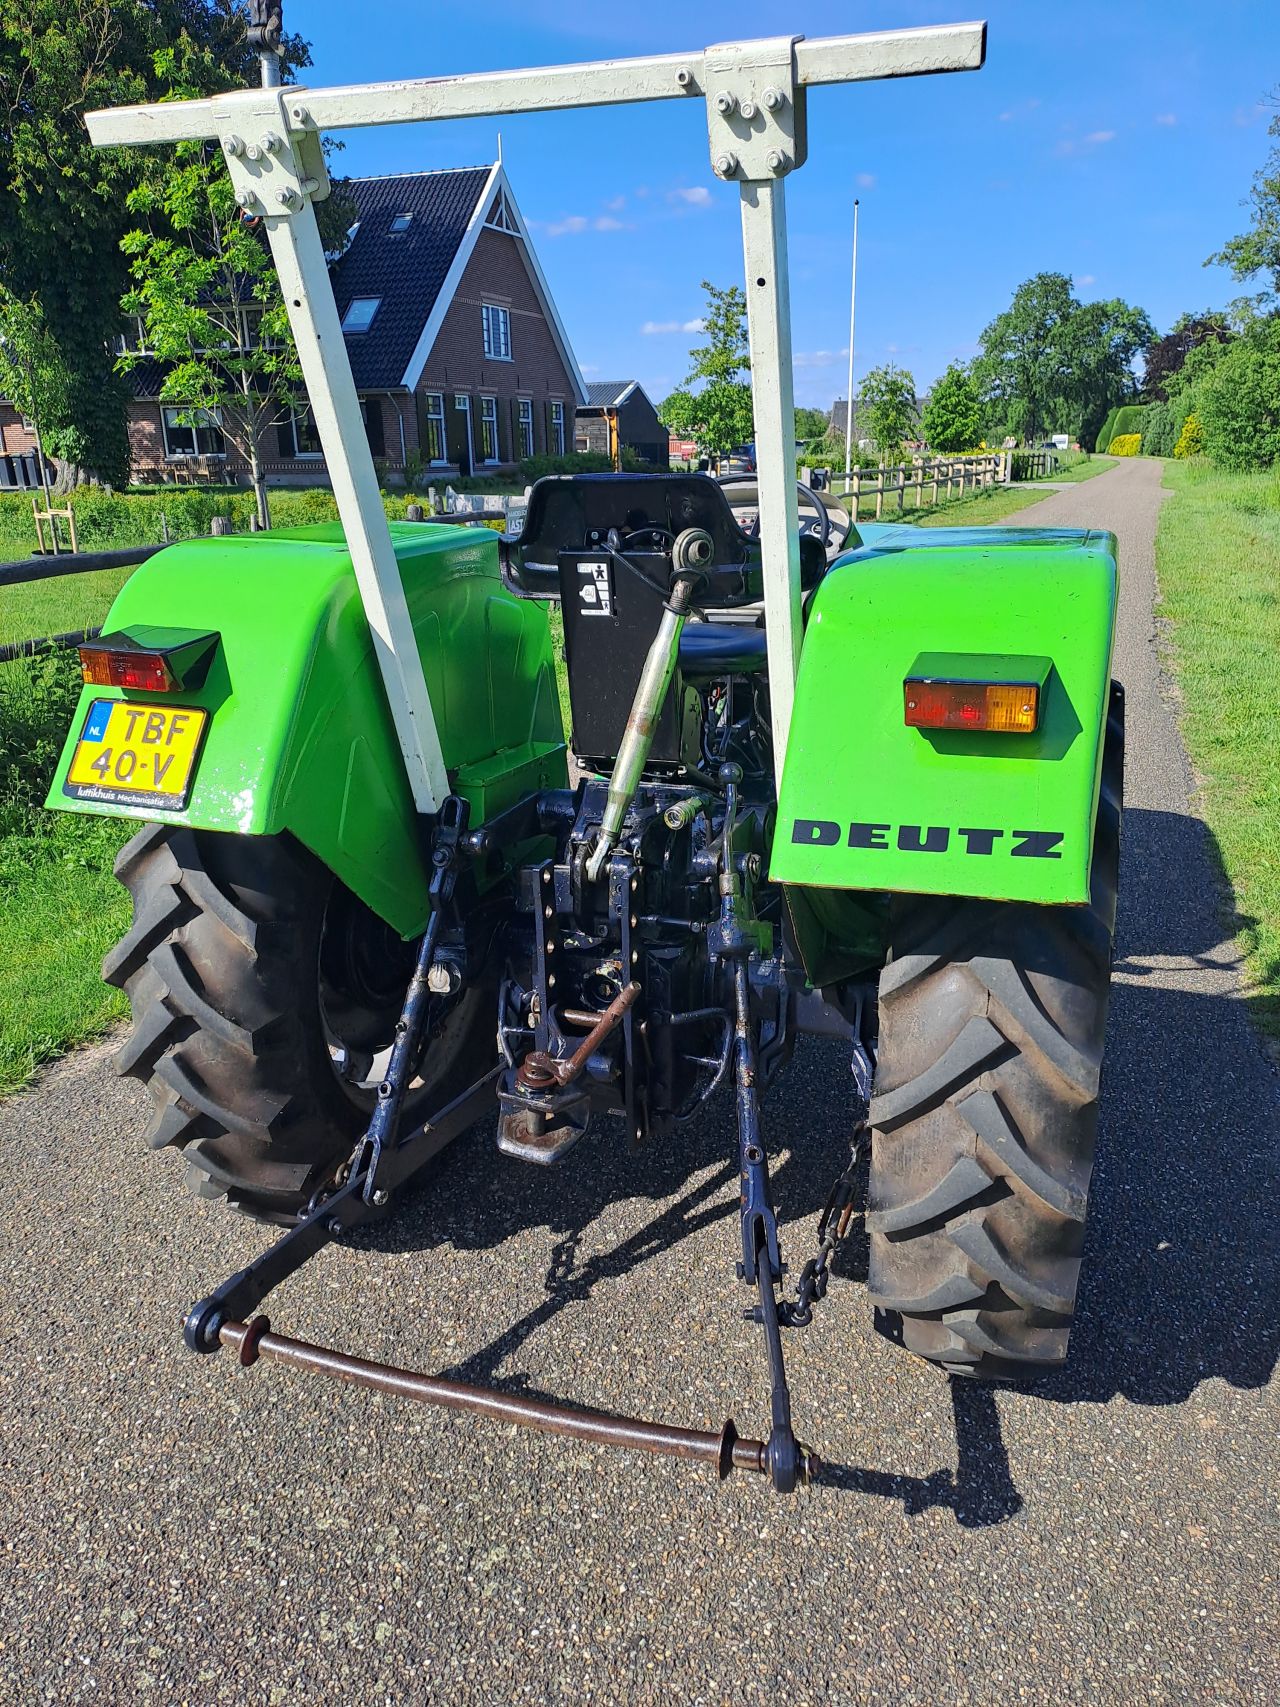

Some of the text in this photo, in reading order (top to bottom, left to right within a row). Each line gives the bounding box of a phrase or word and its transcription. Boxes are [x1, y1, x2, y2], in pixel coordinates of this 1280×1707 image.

[89, 726, 101, 736] NL
[126, 710, 190, 746] TBF
[91, 748, 175, 786] 40-V
[791, 818, 1065, 859] DEUTZ
